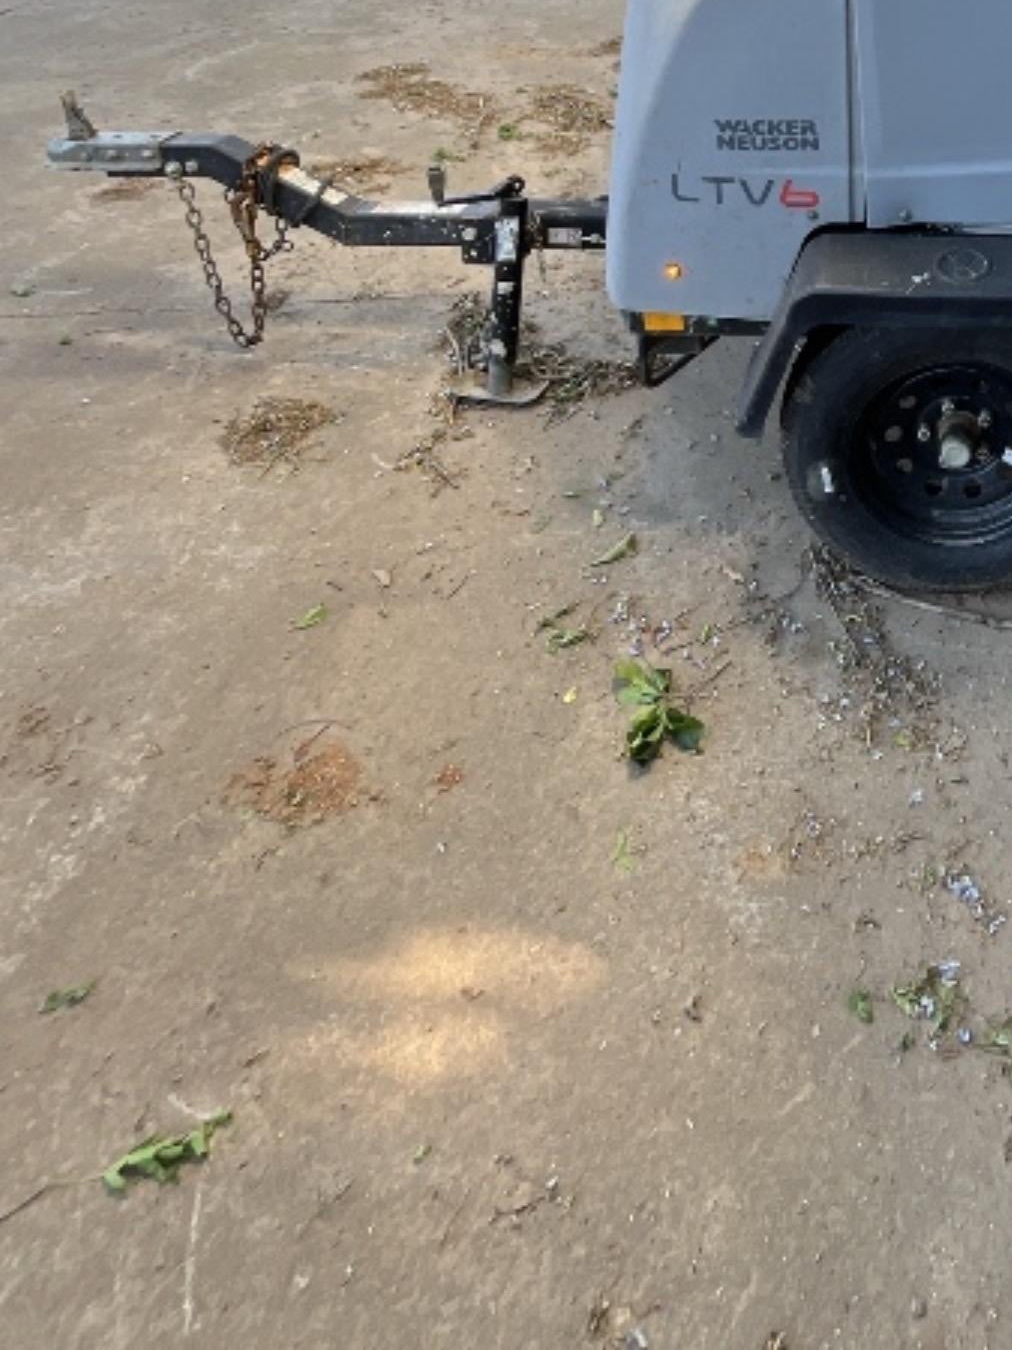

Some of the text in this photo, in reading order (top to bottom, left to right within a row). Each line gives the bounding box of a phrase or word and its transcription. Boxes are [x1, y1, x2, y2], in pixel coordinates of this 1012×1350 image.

[714, 119, 817, 135] WACKER
[716, 135, 820, 151] NEUSON
[671, 173, 820, 208] LTV6
